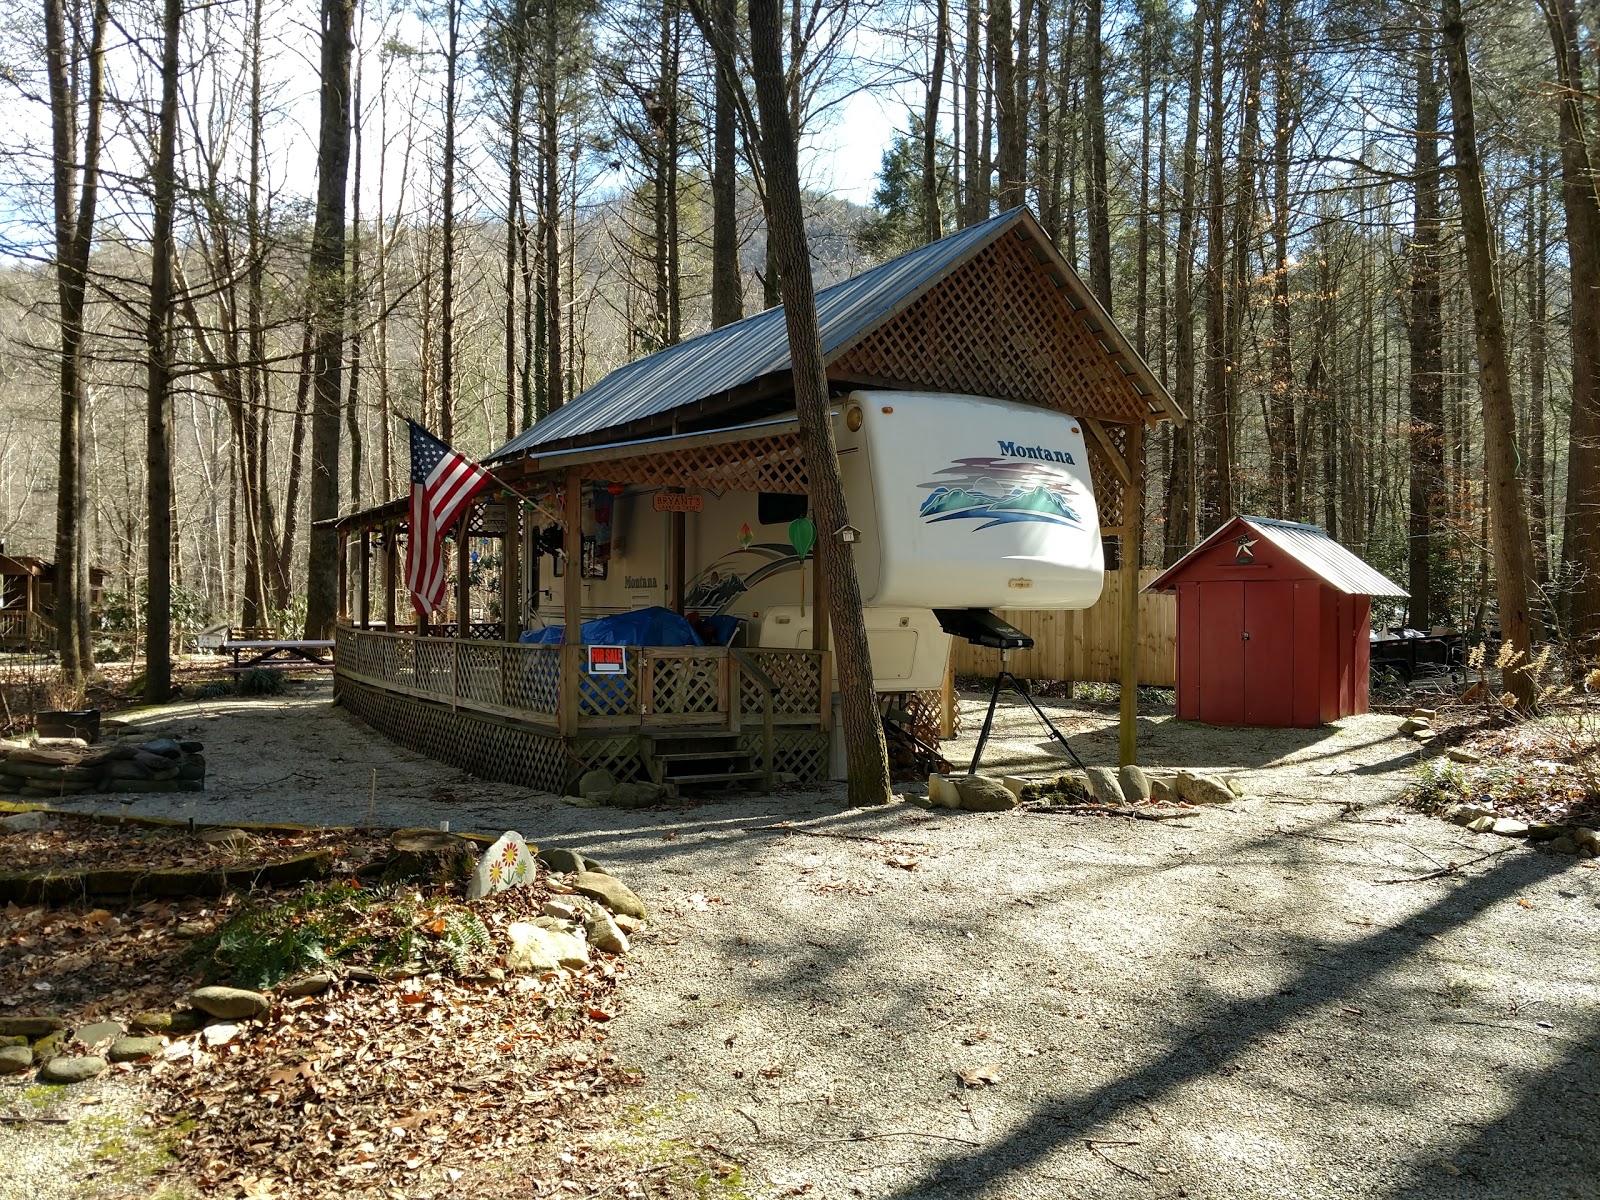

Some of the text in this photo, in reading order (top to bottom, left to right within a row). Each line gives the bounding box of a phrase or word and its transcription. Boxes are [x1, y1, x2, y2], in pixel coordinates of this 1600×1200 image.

[997, 440, 1076, 466] Montana
[657, 496, 701, 505] BRYANT'S
[624, 575, 658, 589] Montana
[591, 648, 622, 663] FOR SALE
